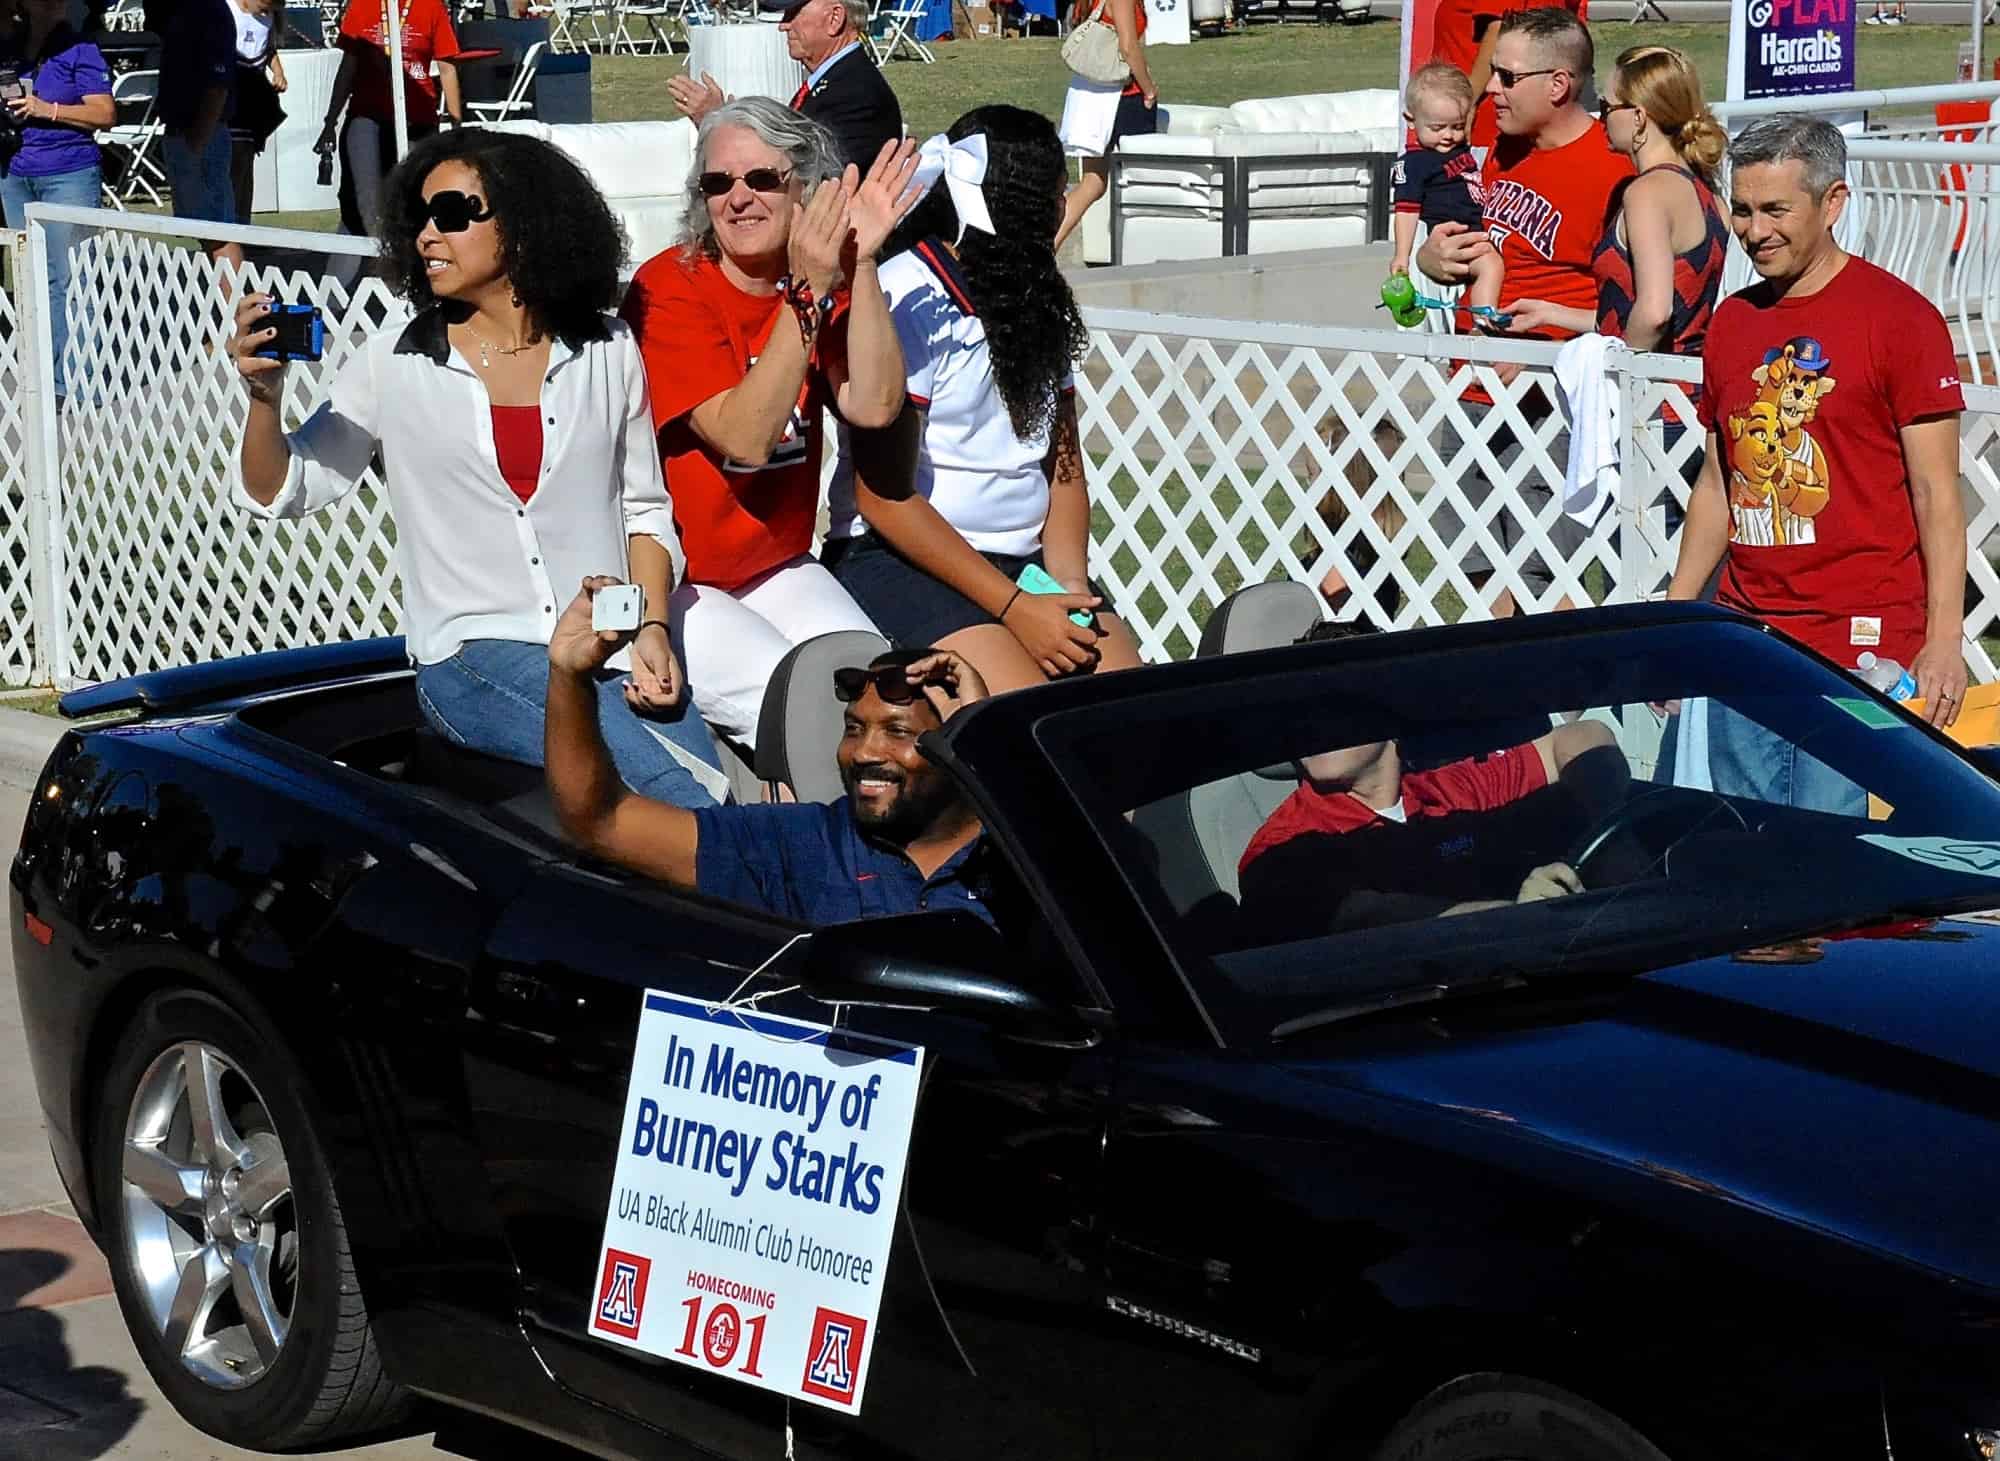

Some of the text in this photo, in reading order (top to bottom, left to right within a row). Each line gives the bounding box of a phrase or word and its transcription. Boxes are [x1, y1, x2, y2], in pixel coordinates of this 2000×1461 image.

[1809, 61, 1841, 74] CASINO
[1483, 180, 1562, 261] RIZONA
[663, 1034, 881, 1133] In Memory of
[632, 1097, 883, 1215] Burney Starks
[618, 1188, 873, 1285] UA Black Alumni Club Honoree
[687, 1270, 776, 1309] HOMECOMING
[674, 1296, 767, 1378] 101
